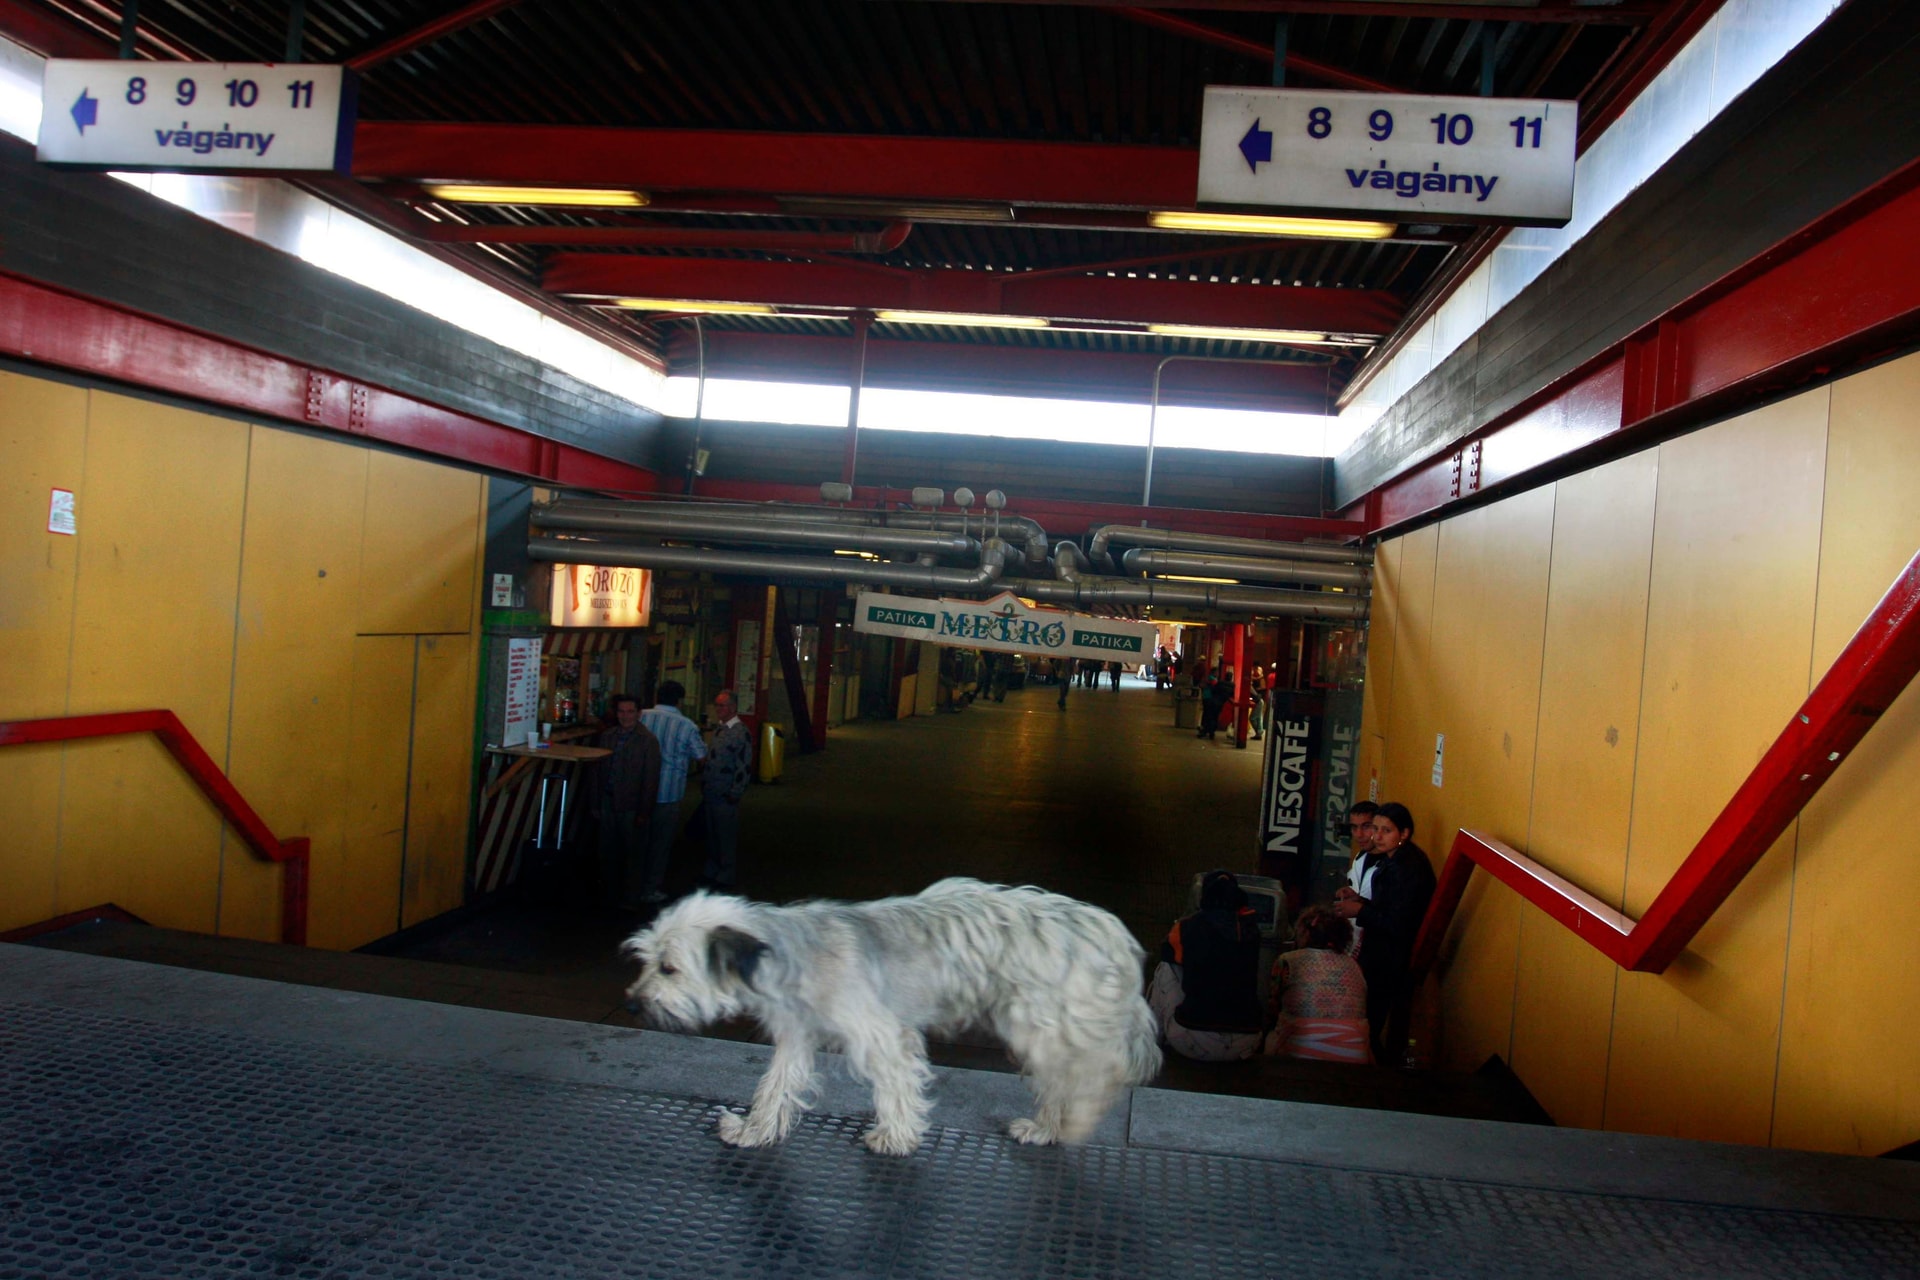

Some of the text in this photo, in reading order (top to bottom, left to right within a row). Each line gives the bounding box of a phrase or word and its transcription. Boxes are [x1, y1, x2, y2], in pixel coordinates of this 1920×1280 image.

[125, 77, 315, 109] 8 9 10 11
[155, 121, 276, 156] vágány
[1307, 107, 1543, 148] 8 9 10 11
[1345, 159, 1499, 201] vágány
[876, 610, 928, 626] PATIKA
[1081, 633, 1133, 649] PATIKA
[1266, 719, 1310, 855] NESCAFÉ
